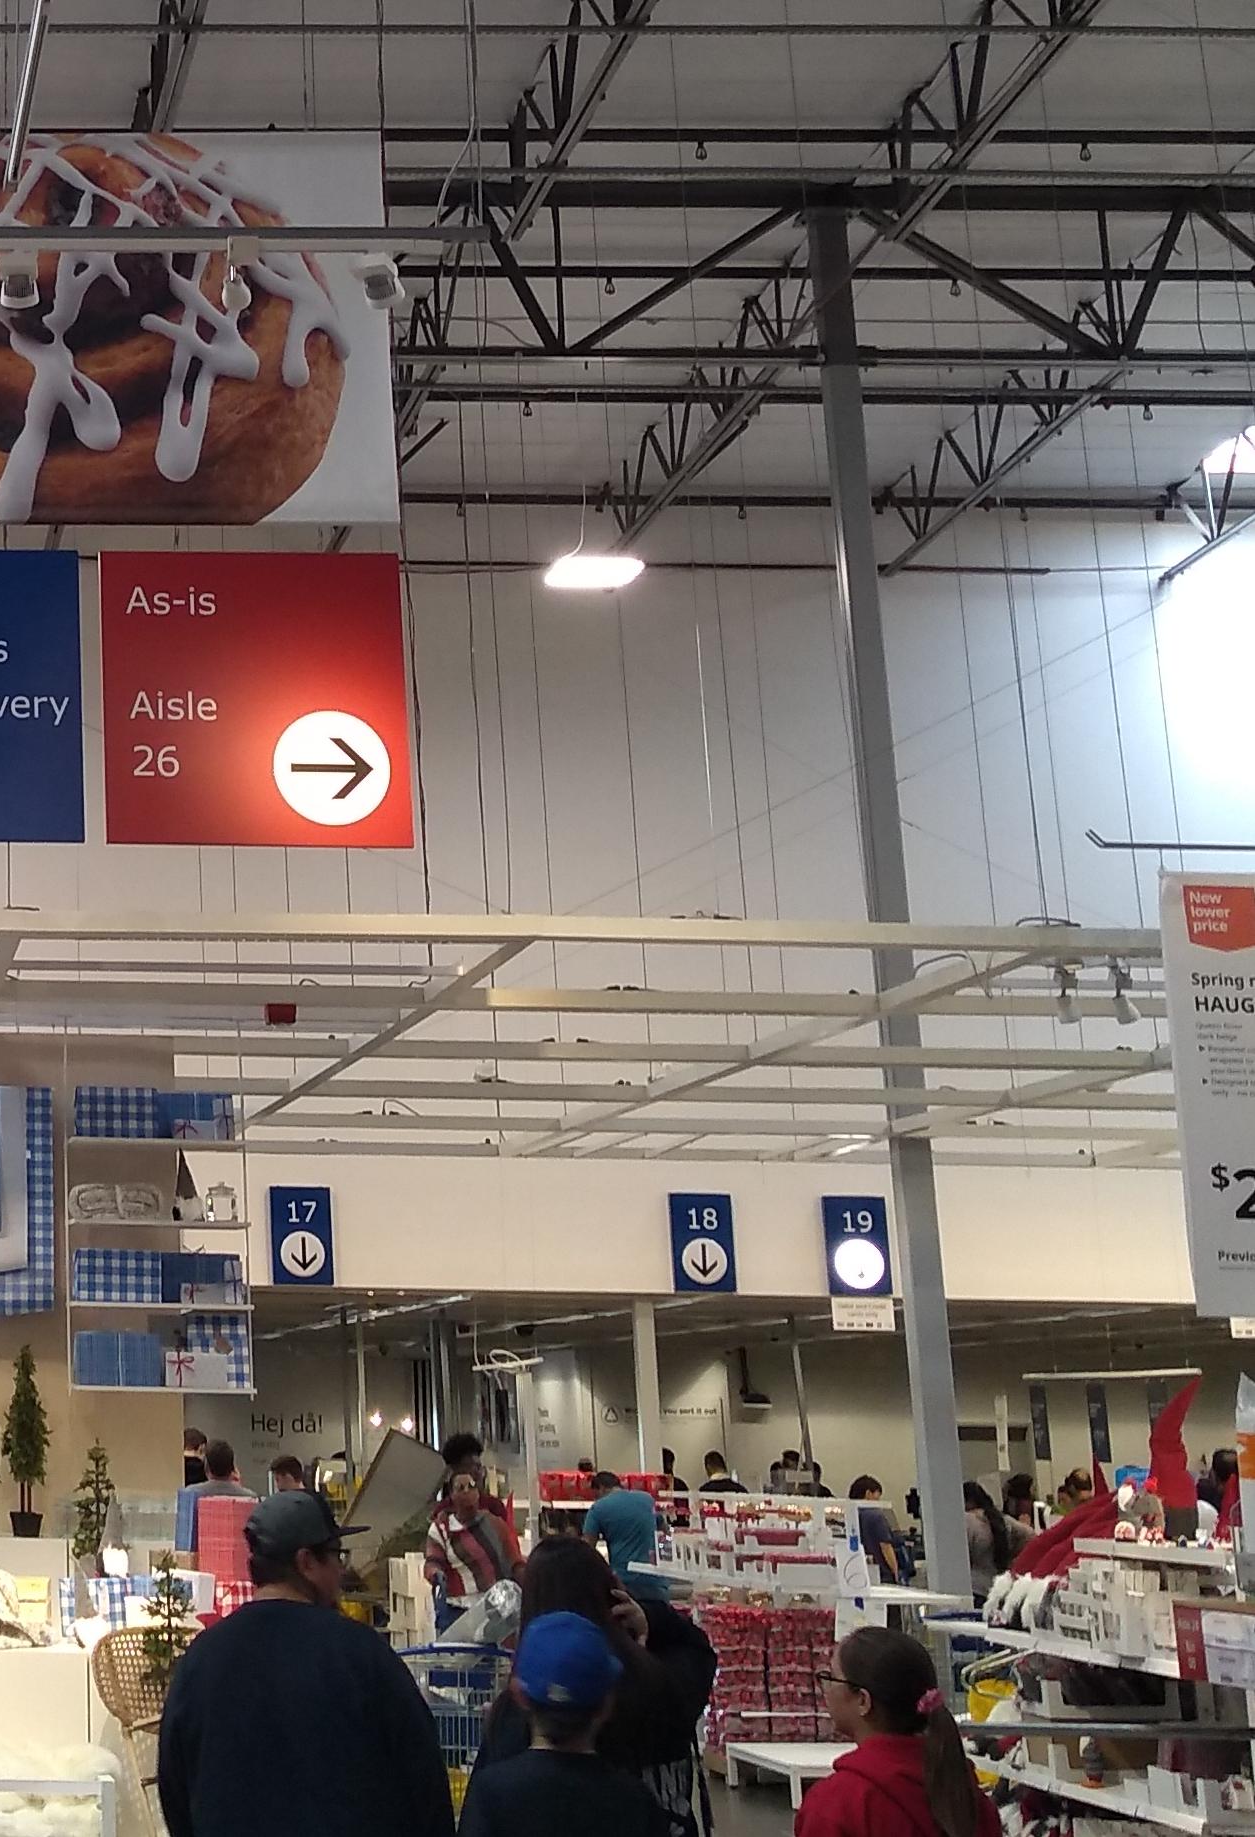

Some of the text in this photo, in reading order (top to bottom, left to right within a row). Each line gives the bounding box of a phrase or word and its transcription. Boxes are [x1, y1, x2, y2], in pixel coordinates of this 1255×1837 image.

[126, 586, 218, 617] As-is
[130, 691, 219, 722] Aisle
[132, 744, 181, 779] 26
[1189, 890, 1223, 905] New
[1190, 904, 1232, 918] lower
[1193, 918, 1229, 935] price
[1191, 971, 1245, 991] Spring
[287, 1200, 317, 1223] 17
[687, 1207, 718, 1230] 18
[842, 1210, 873, 1233] 19
[250, 1411, 323, 1439] Hej då!
